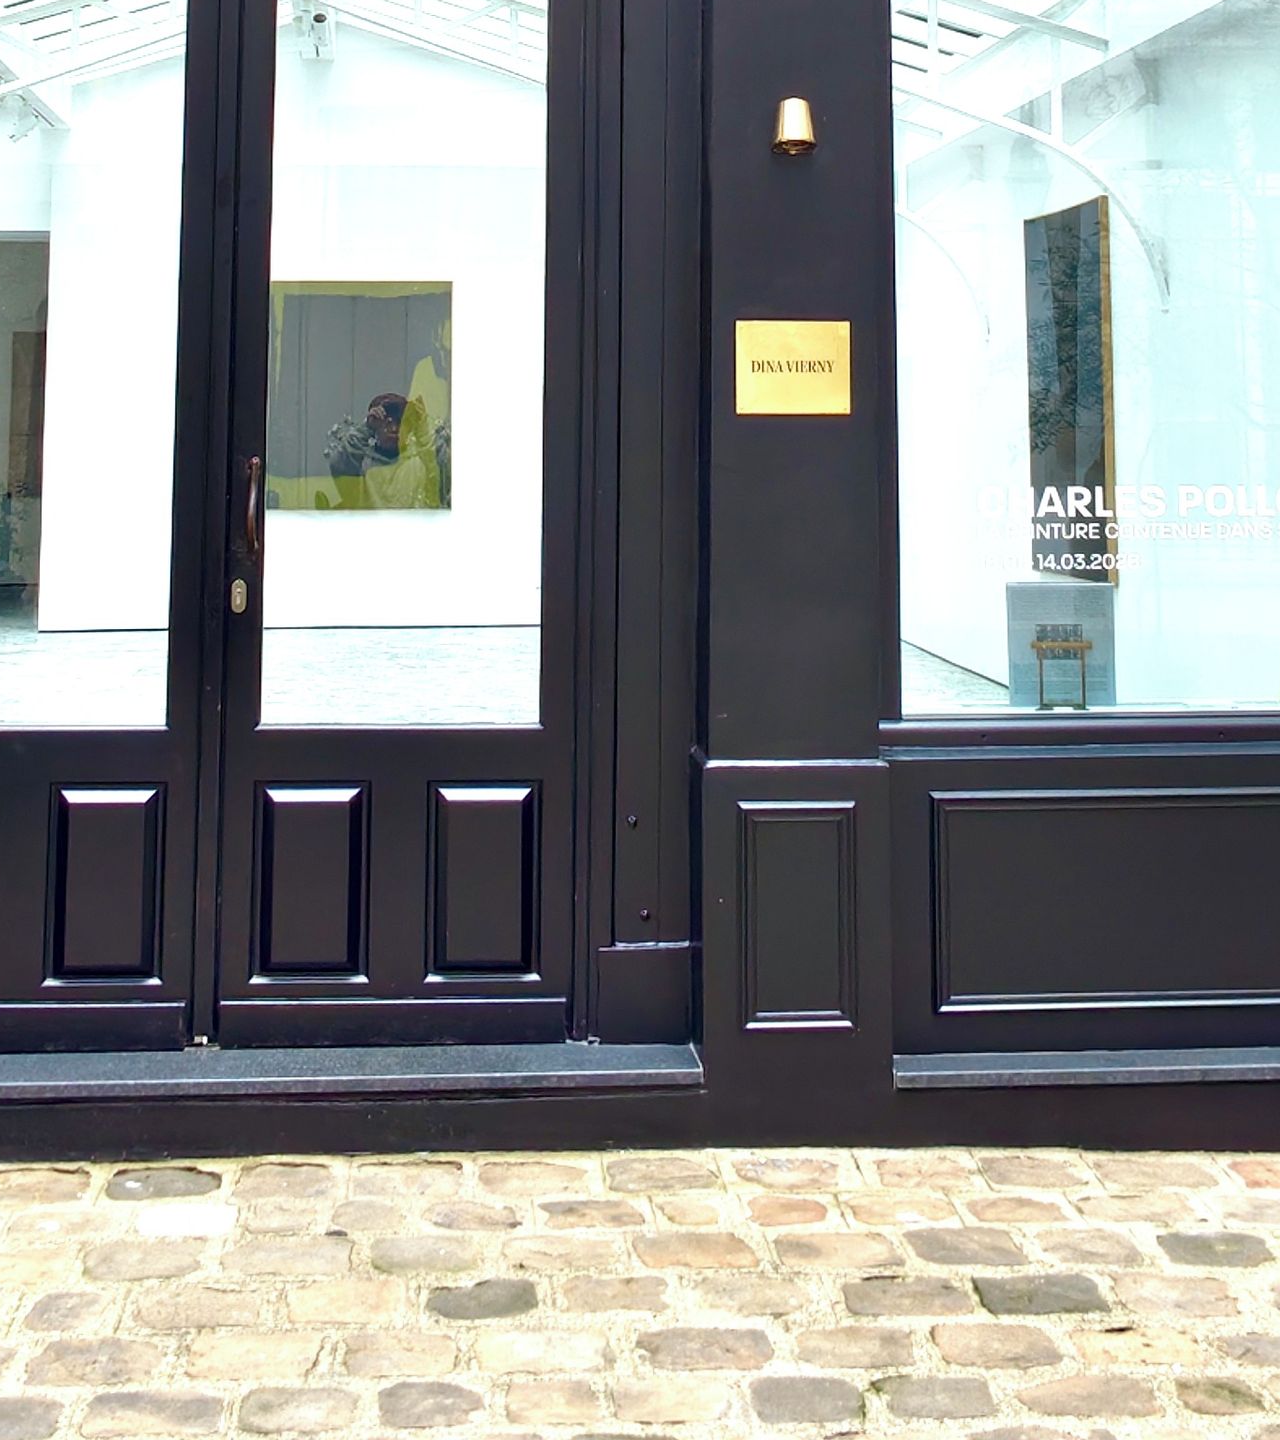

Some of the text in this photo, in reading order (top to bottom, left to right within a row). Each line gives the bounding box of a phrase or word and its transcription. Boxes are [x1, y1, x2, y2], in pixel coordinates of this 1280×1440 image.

[751, 360, 835, 374] DINA VIERNY
[1104, 521, 1212, 540] CONTENUE
[1216, 521, 1273, 539] DANS
